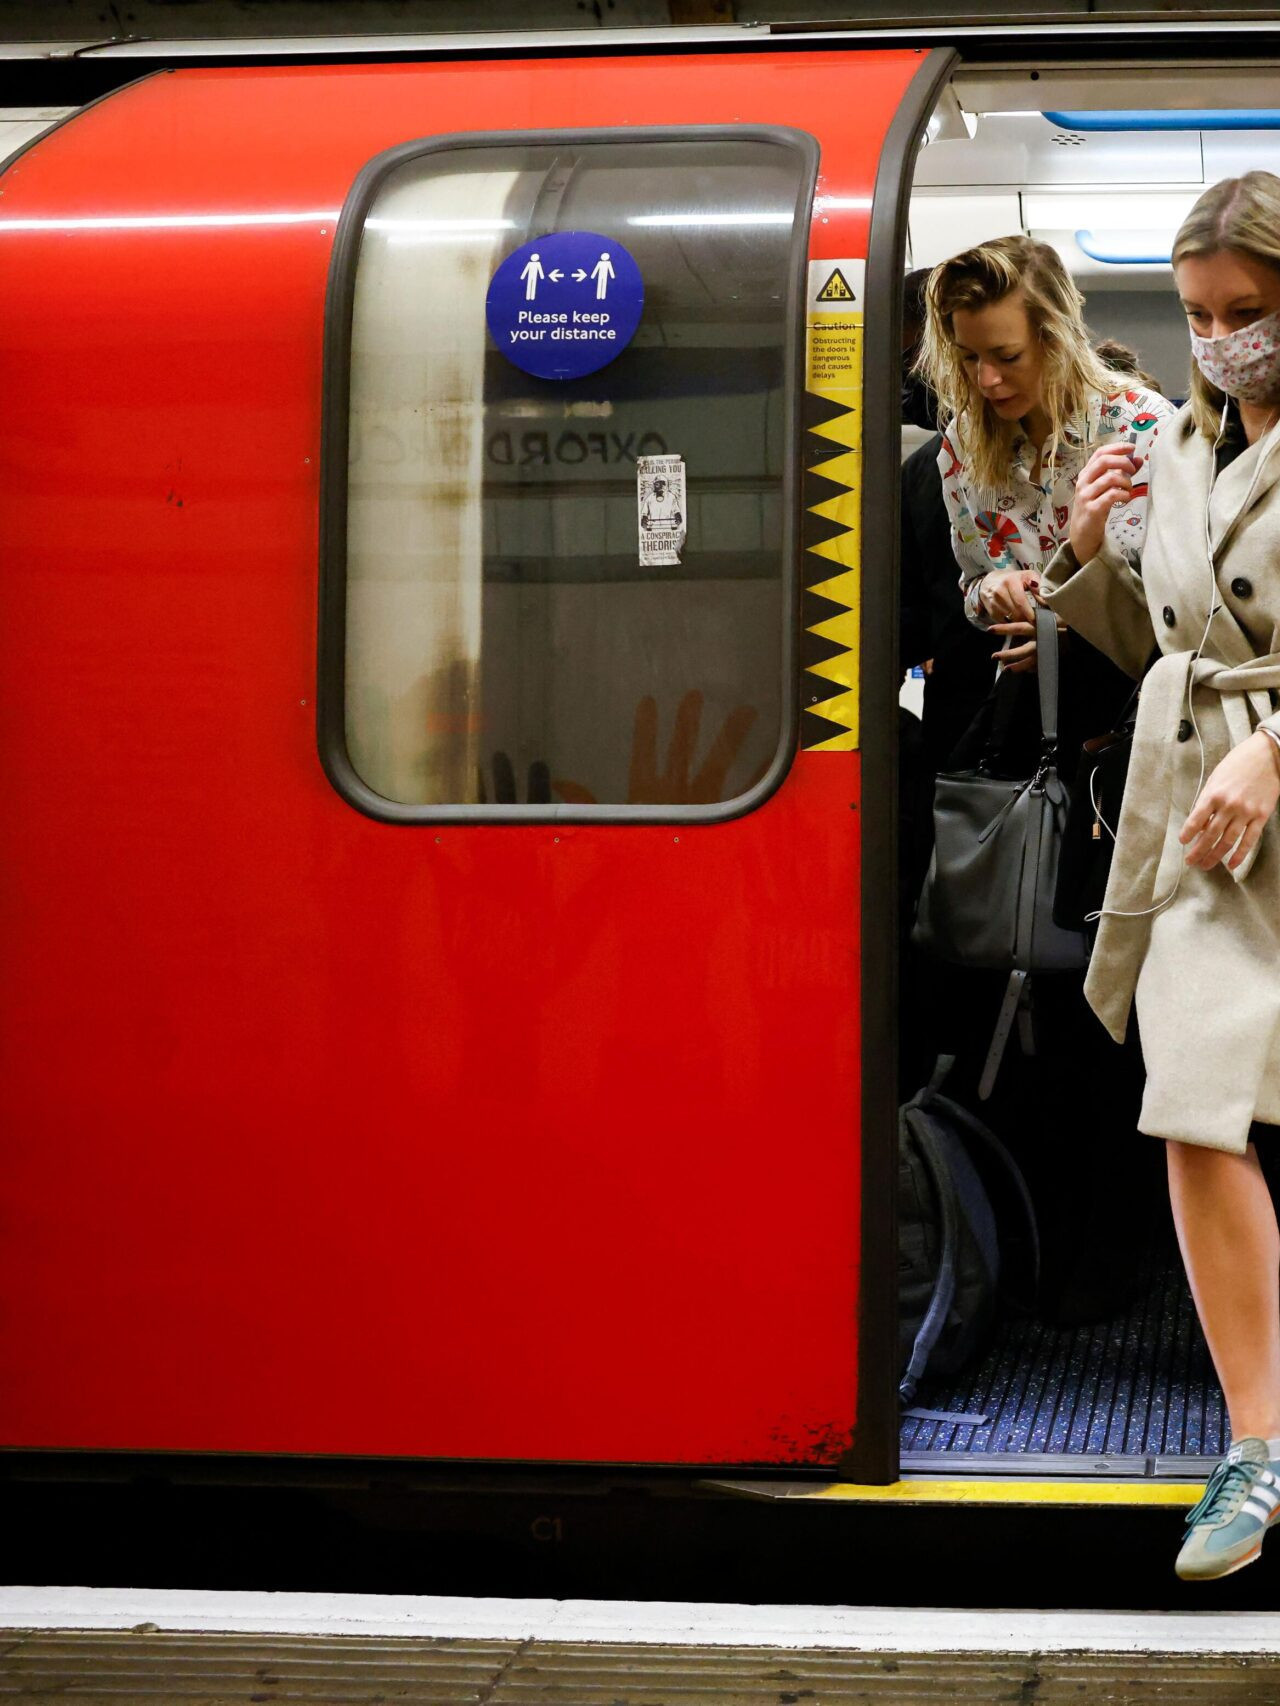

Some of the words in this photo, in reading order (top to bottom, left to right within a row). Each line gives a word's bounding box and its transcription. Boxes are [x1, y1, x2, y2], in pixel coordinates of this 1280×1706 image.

[518, 310, 568, 324] Please
[572, 310, 610, 326] keep
[813, 321, 856, 330] Caution
[510, 329, 546, 343] your
[550, 327, 616, 340] distance
[812, 337, 856, 345] Obstructing
[668, 464, 682, 473] YOU
[641, 532, 645, 540] A
[530, 1514, 562, 1541] C1
